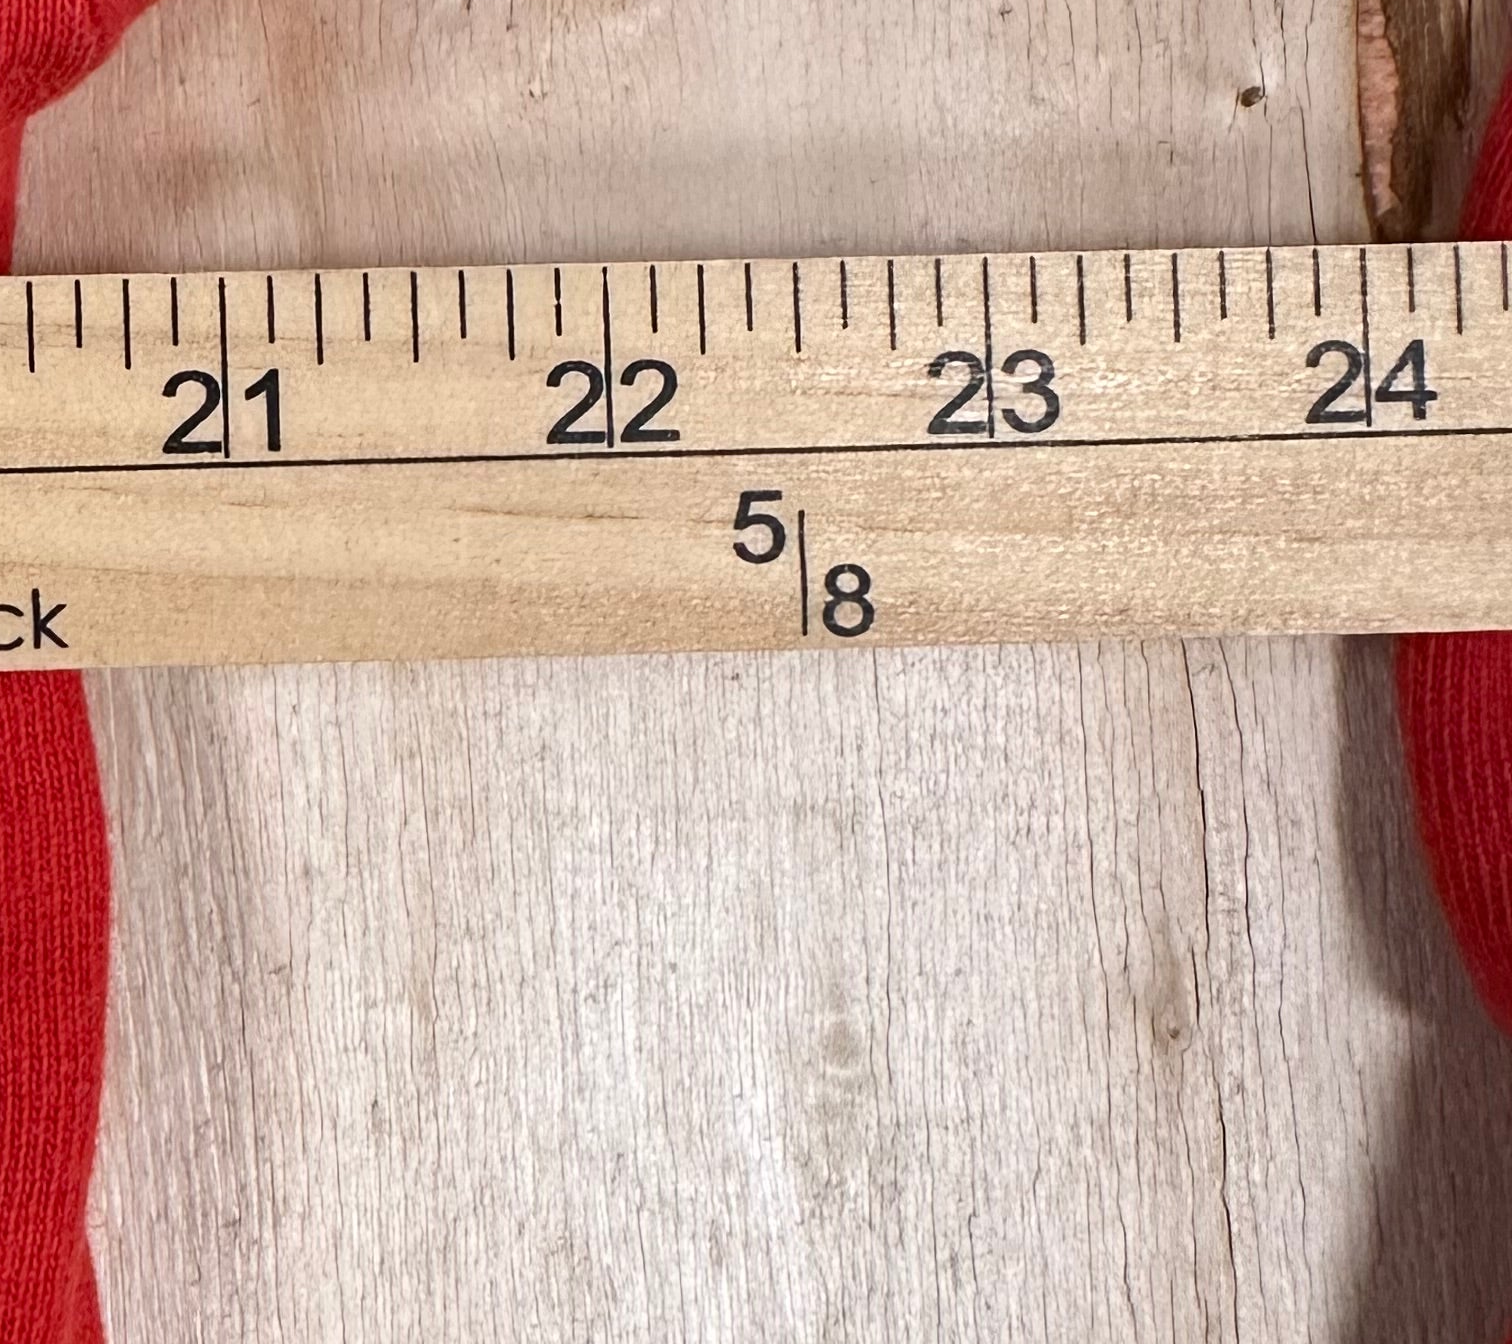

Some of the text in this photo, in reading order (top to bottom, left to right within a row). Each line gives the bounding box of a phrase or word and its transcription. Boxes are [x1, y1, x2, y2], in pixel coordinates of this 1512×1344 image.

[162, 369, 282, 455] 21
[546, 360, 681, 445] 22
[927, 350, 1060, 435] 23
[1305, 340, 1437, 424] 24
